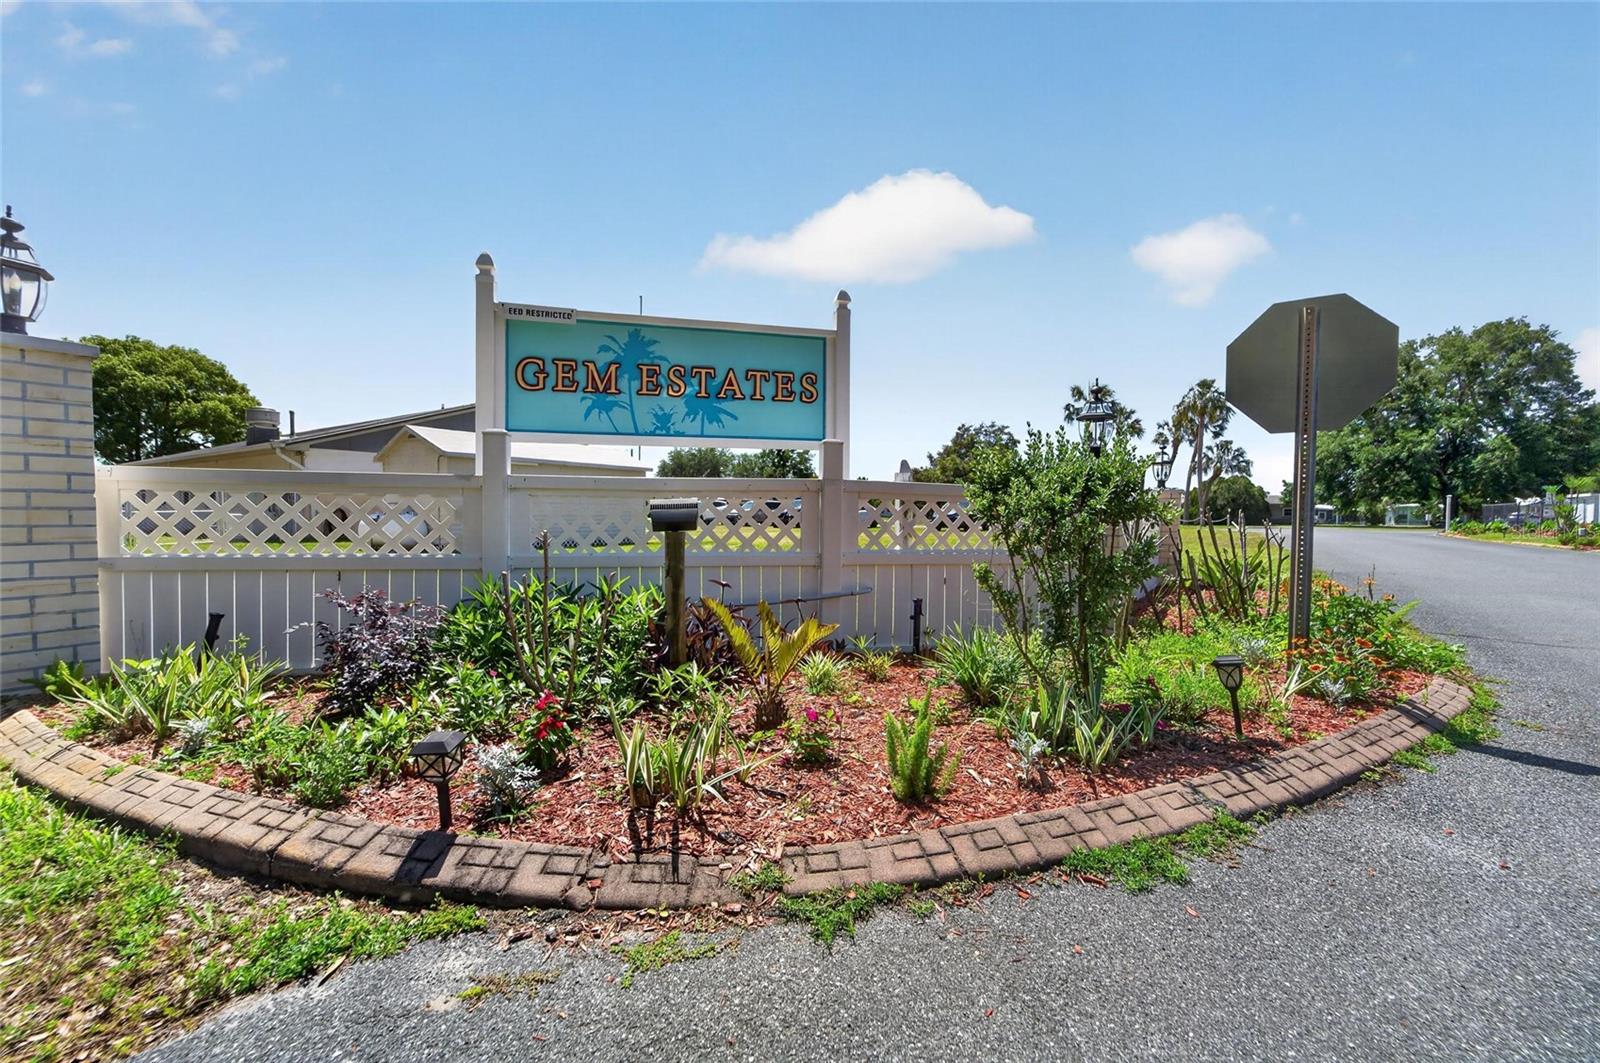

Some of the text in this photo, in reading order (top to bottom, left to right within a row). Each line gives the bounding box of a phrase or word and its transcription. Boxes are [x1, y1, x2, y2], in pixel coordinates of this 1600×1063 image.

[526, 308, 573, 320] RESTRICTED
[515, 356, 819, 404] GEM ESTATES
